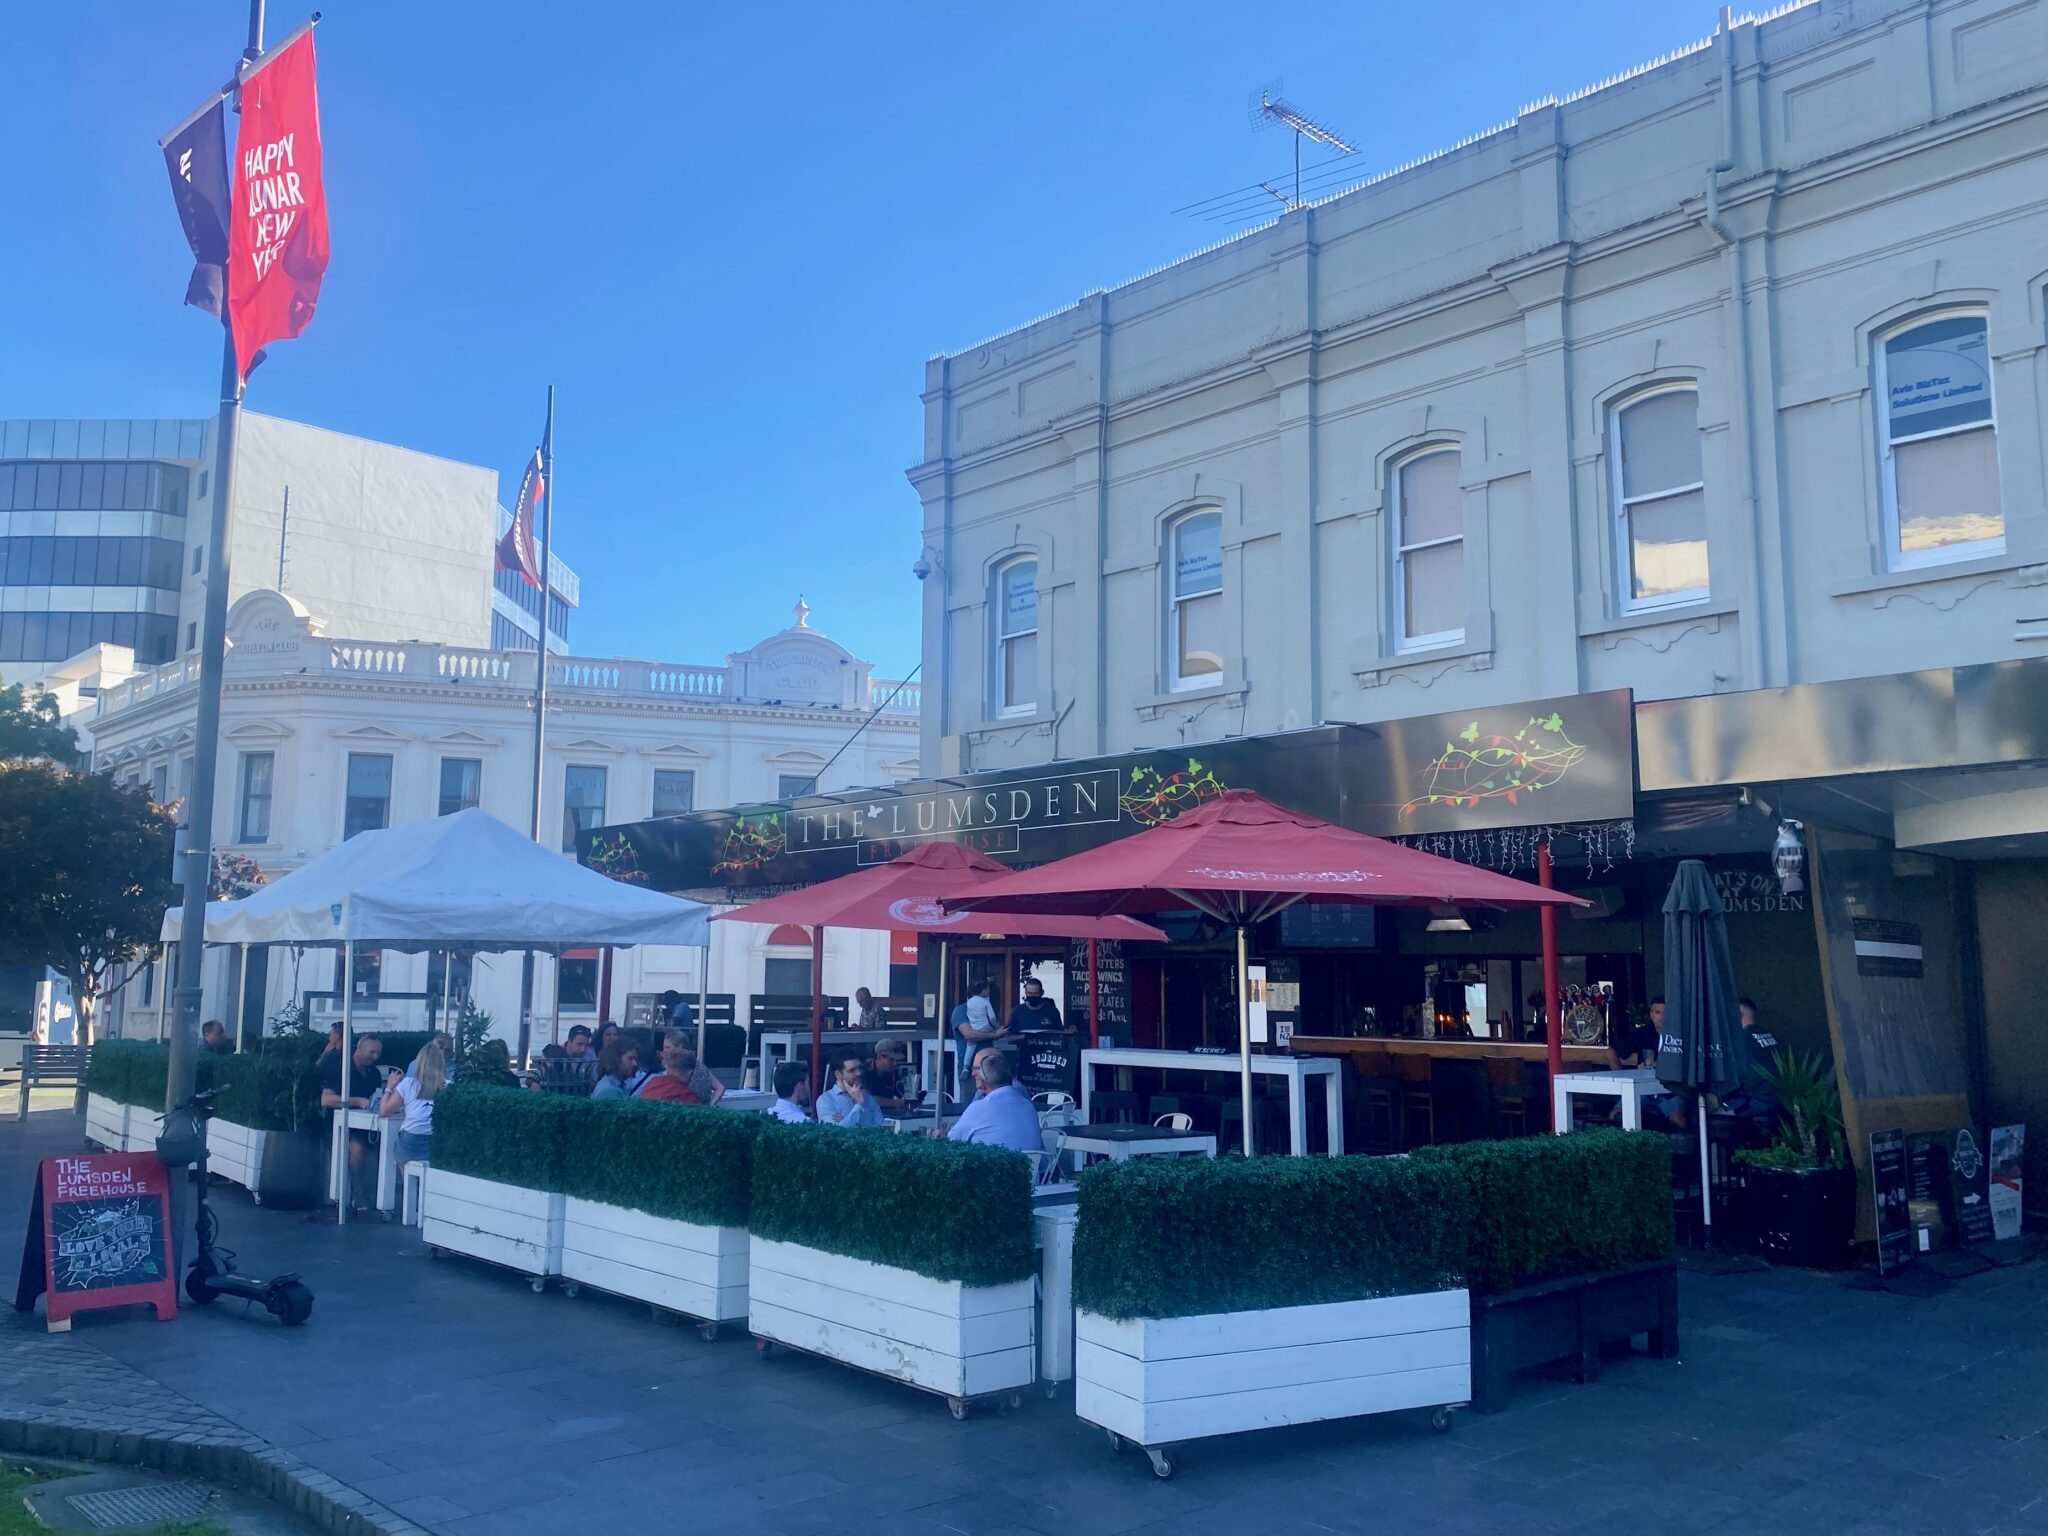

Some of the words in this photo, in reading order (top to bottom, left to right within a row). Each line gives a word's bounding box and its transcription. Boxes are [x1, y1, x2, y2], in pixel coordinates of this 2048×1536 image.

[244, 132, 294, 182] HAPPY
[248, 171, 305, 217] LUNAR
[256, 210, 296, 248] NEW
[1942, 382, 1983, 397] Limited
[274, 639, 299, 653] CLUB
[776, 676, 822, 689] CLUB
[798, 809, 865, 843] THE
[891, 780, 1101, 835] LUMSDEN
[1723, 895, 1804, 912] UMSDEN
[56, 1159, 92, 1174] THE
[57, 1167, 131, 1186] LUMSDEN
[57, 1182, 147, 1198] FREEHOUSE
[66, 1235, 106, 1254] LOVE
[105, 1216, 147, 1243] YOUR
